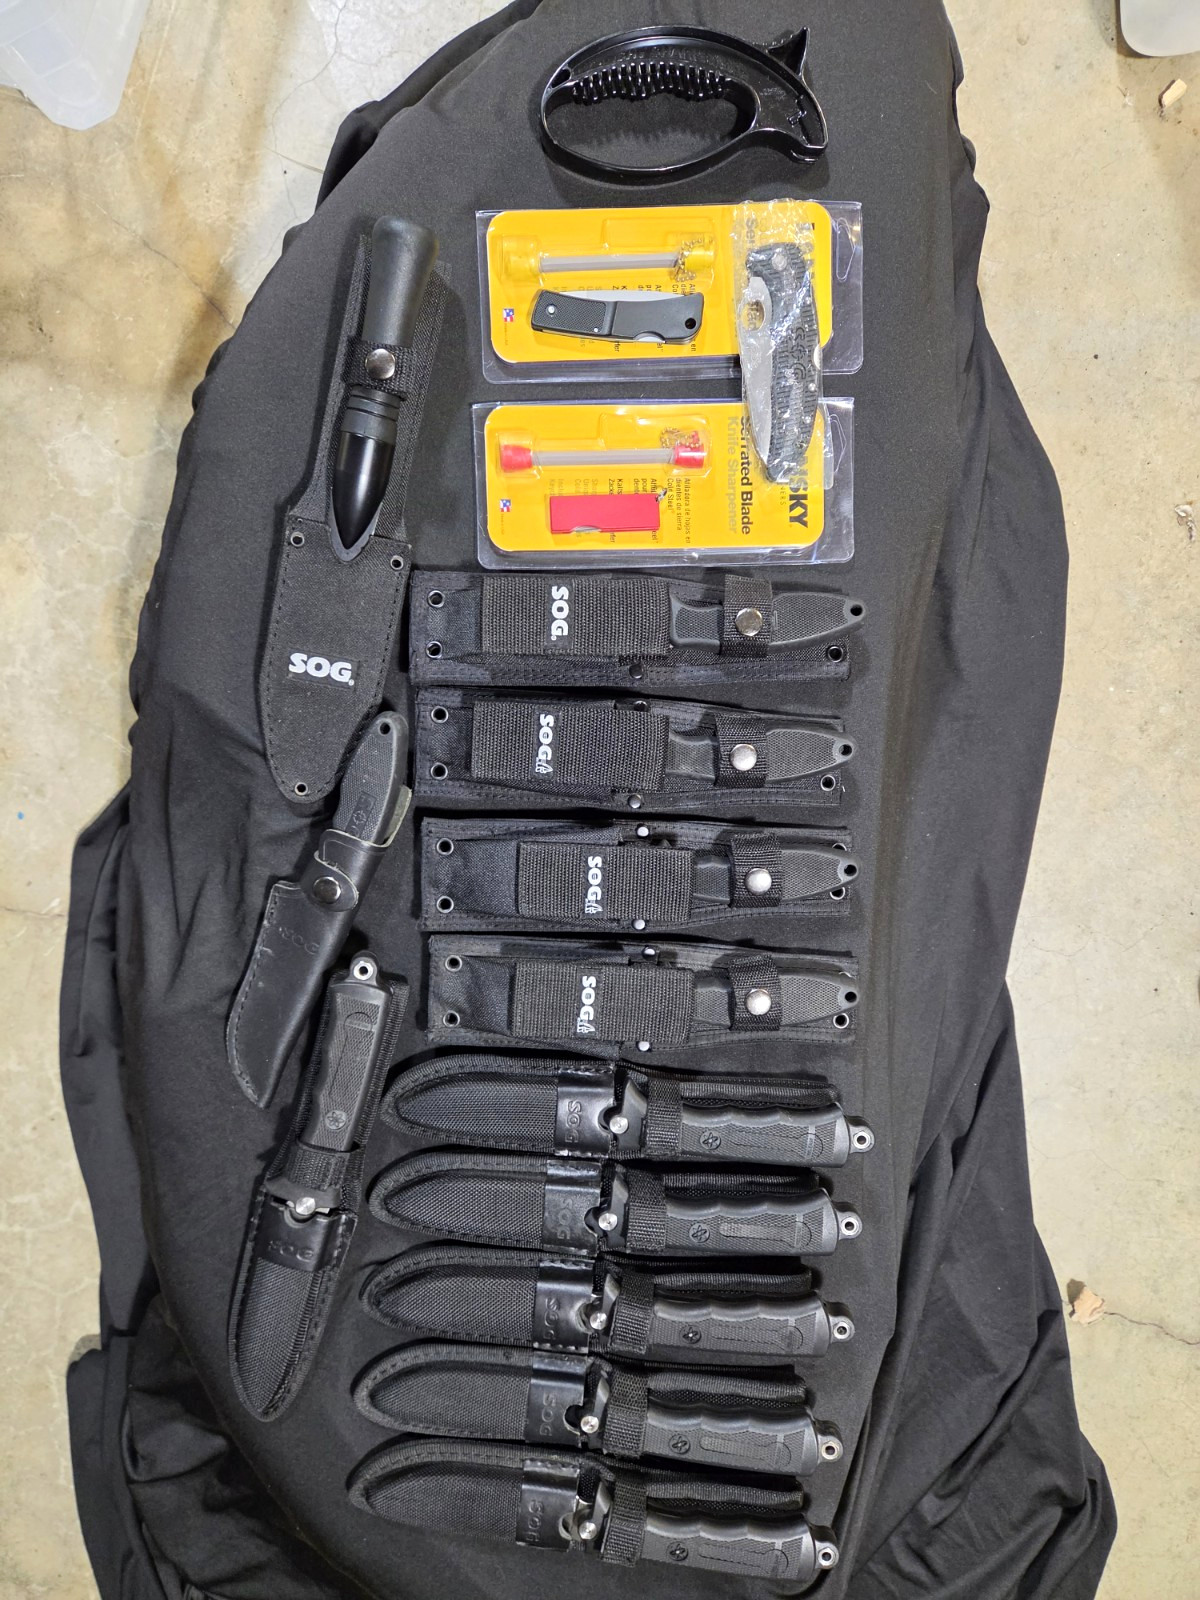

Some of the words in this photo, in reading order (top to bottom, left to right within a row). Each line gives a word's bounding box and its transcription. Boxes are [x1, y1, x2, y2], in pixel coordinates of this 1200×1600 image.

[727, 415, 739, 456] Knife
[725, 459, 740, 534] Sharpener
[741, 490, 754, 535] Blade
[788, 455, 809, 529] NSKY
[565, 1100, 582, 1143] SOG
[556, 1198, 573, 1240] SOG
